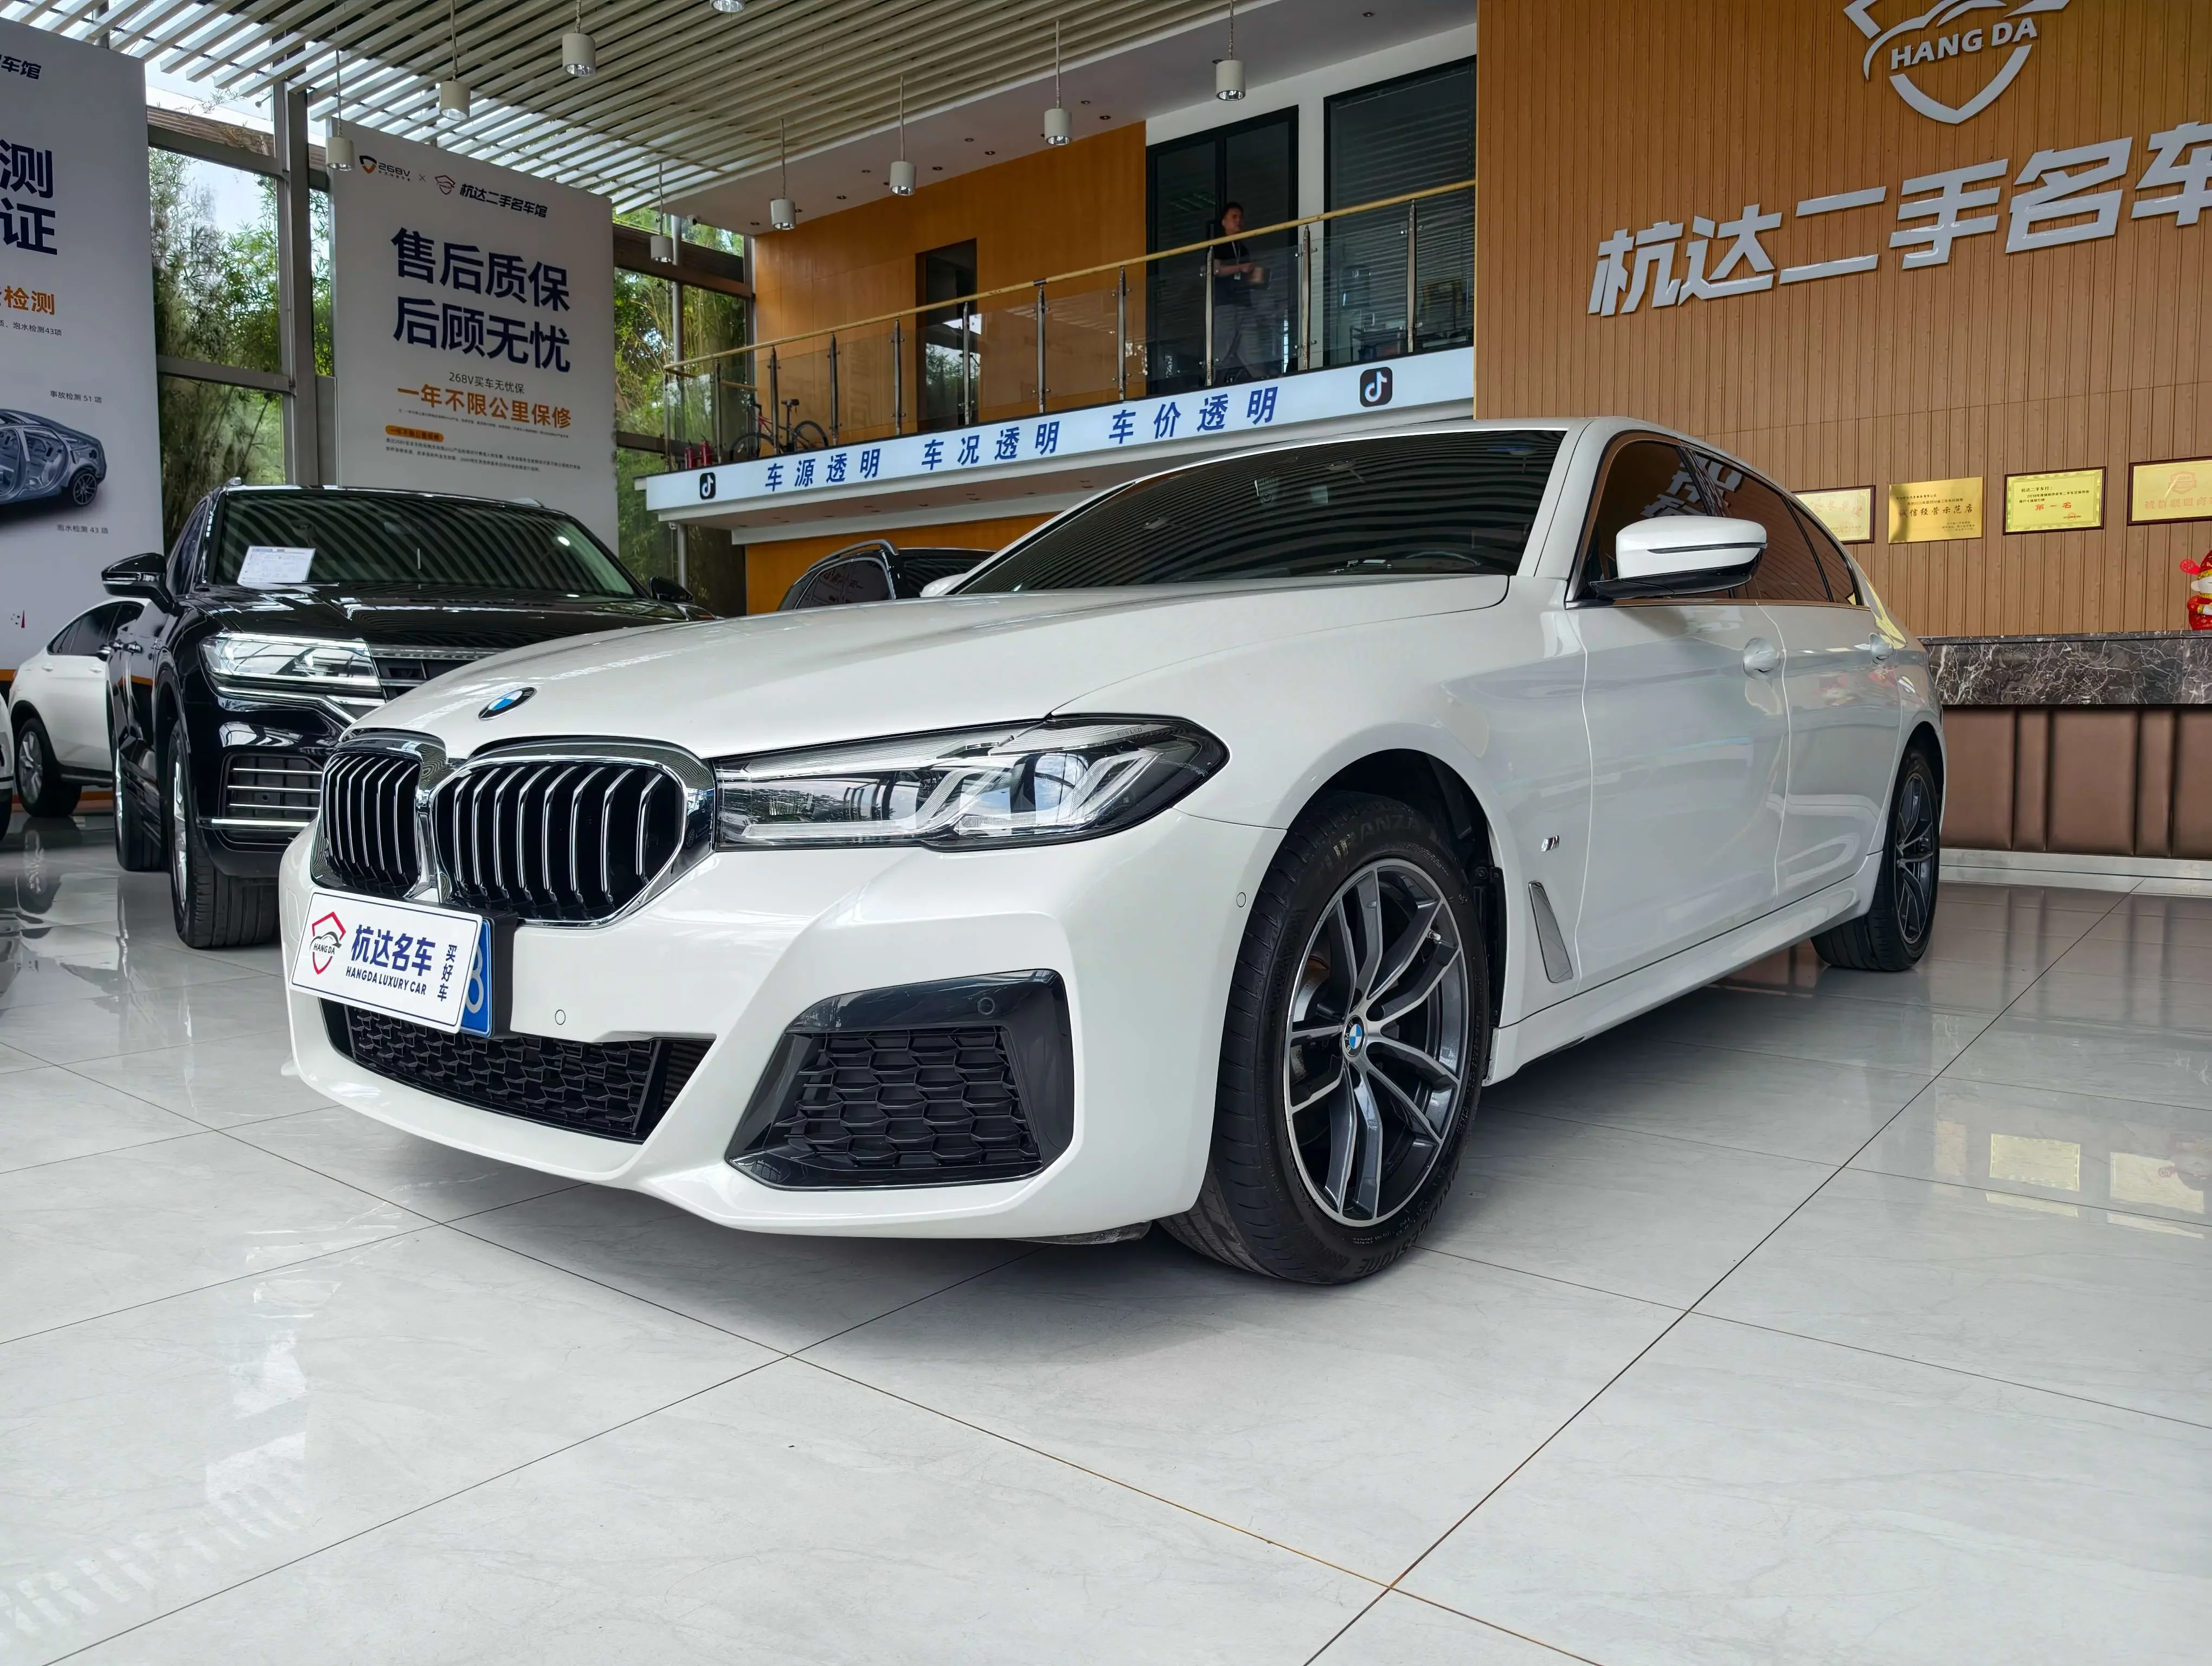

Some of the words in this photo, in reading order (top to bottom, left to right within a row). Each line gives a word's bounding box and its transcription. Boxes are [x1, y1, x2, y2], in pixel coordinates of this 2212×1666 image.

[1891, 29, 1983, 70] HANG
[1990, 17, 2038, 48] DA
[0, 54, 41, 79] 车馆
[0, 139, 53, 198] 测
[378, 163, 410, 176] 268V
[460, 184, 548, 217] 杭达二手名车馆
[1588, 121, 2212, 317] 杭达二手名车
[0, 197, 57, 255] 证
[391, 227, 571, 312] 售后质保
[0, 286, 55, 316] 检测
[393, 296, 571, 373] 后顾无忧
[449, 371, 525, 394] 268V买车无忧保
[397, 383, 571, 428] 一年不限公里保修
[765, 448, 881, 492] 车源透明
[922, 421, 1060, 470] 车况透明
[1109, 386, 1279, 445] 车价透明
[1900, 503, 1973, 518] 诚信经营示范店
[2035, 502, 2072, 511] 第一名
[313, 943, 327, 952] HANG
[328, 946, 335, 954] DA
[351, 924, 435, 976] 杭达名车
[346, 966, 377, 983] HANGDA
[379, 973, 409, 990] LUXURY
[410, 981, 427, 995] CAR
[437, 944, 458, 1002] 买好车
